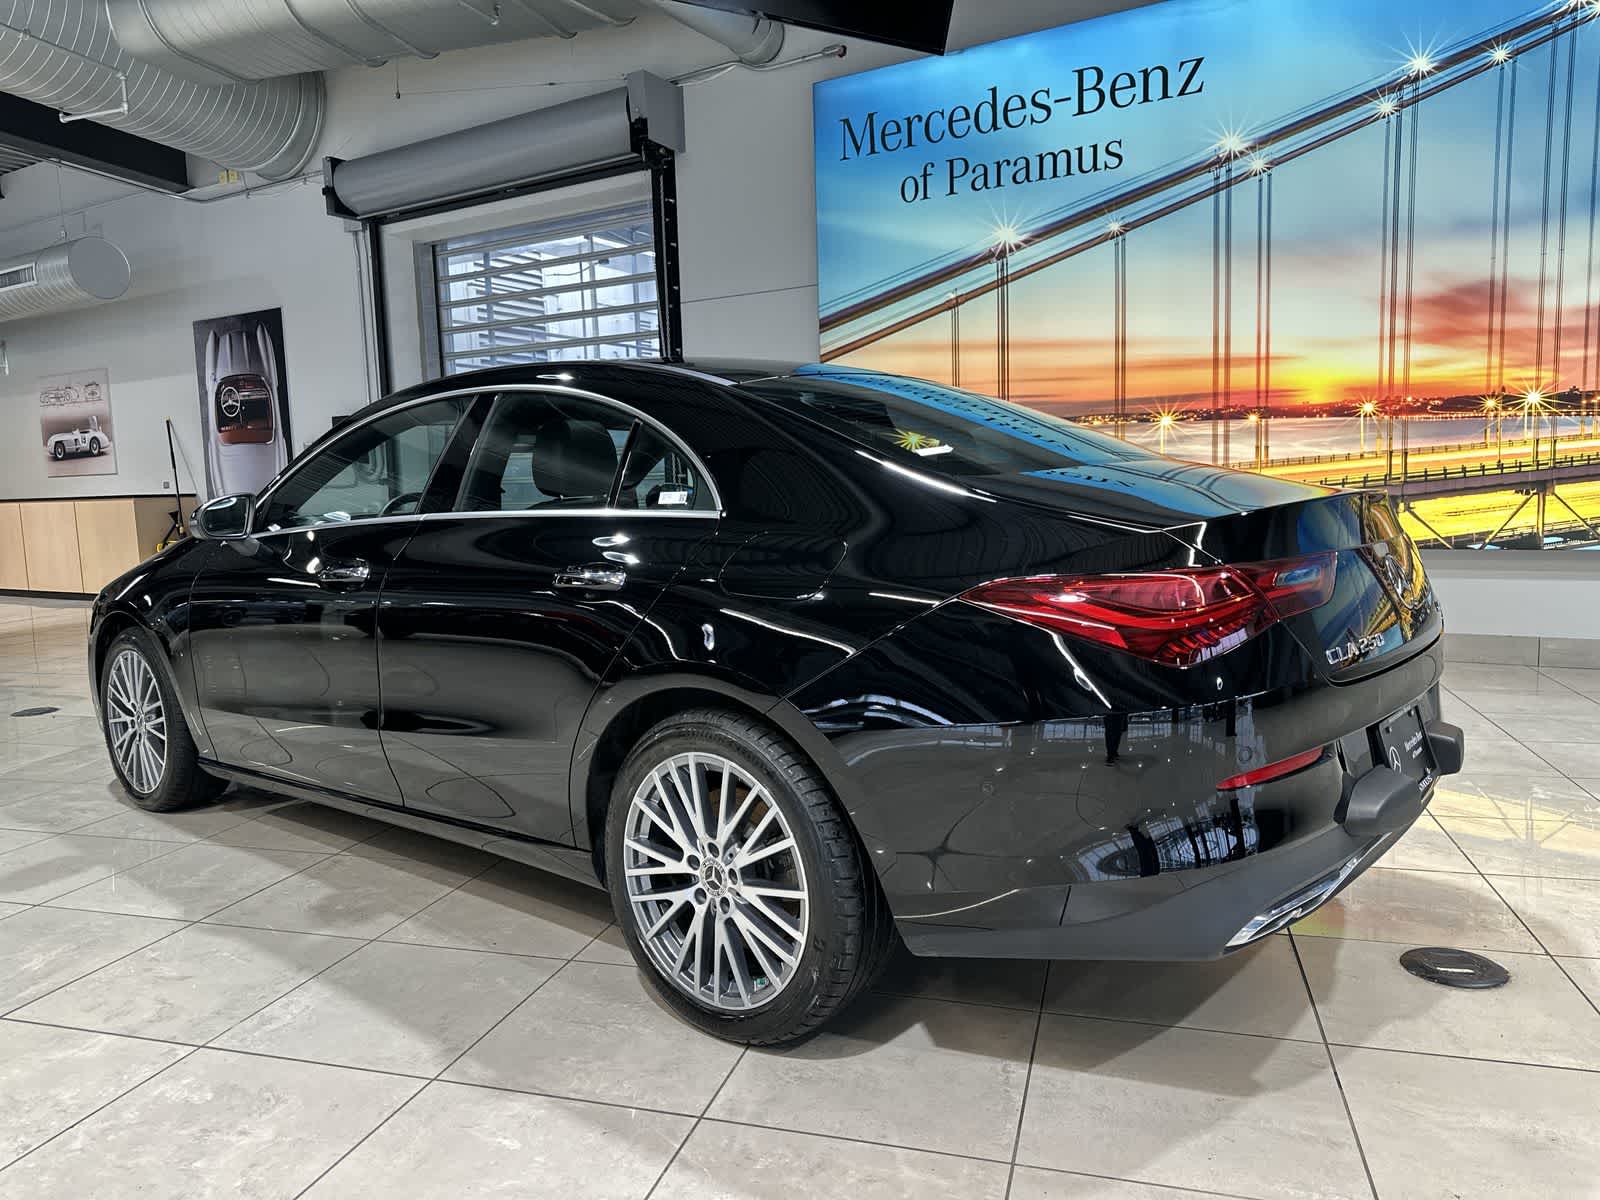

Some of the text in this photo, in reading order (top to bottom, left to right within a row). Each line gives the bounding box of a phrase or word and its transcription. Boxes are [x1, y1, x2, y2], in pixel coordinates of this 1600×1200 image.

[839, 56, 1205, 161] Mercedes-Benz
[900, 138, 1123, 204] of Paramus
[1325, 633, 1385, 665] CLA 250
